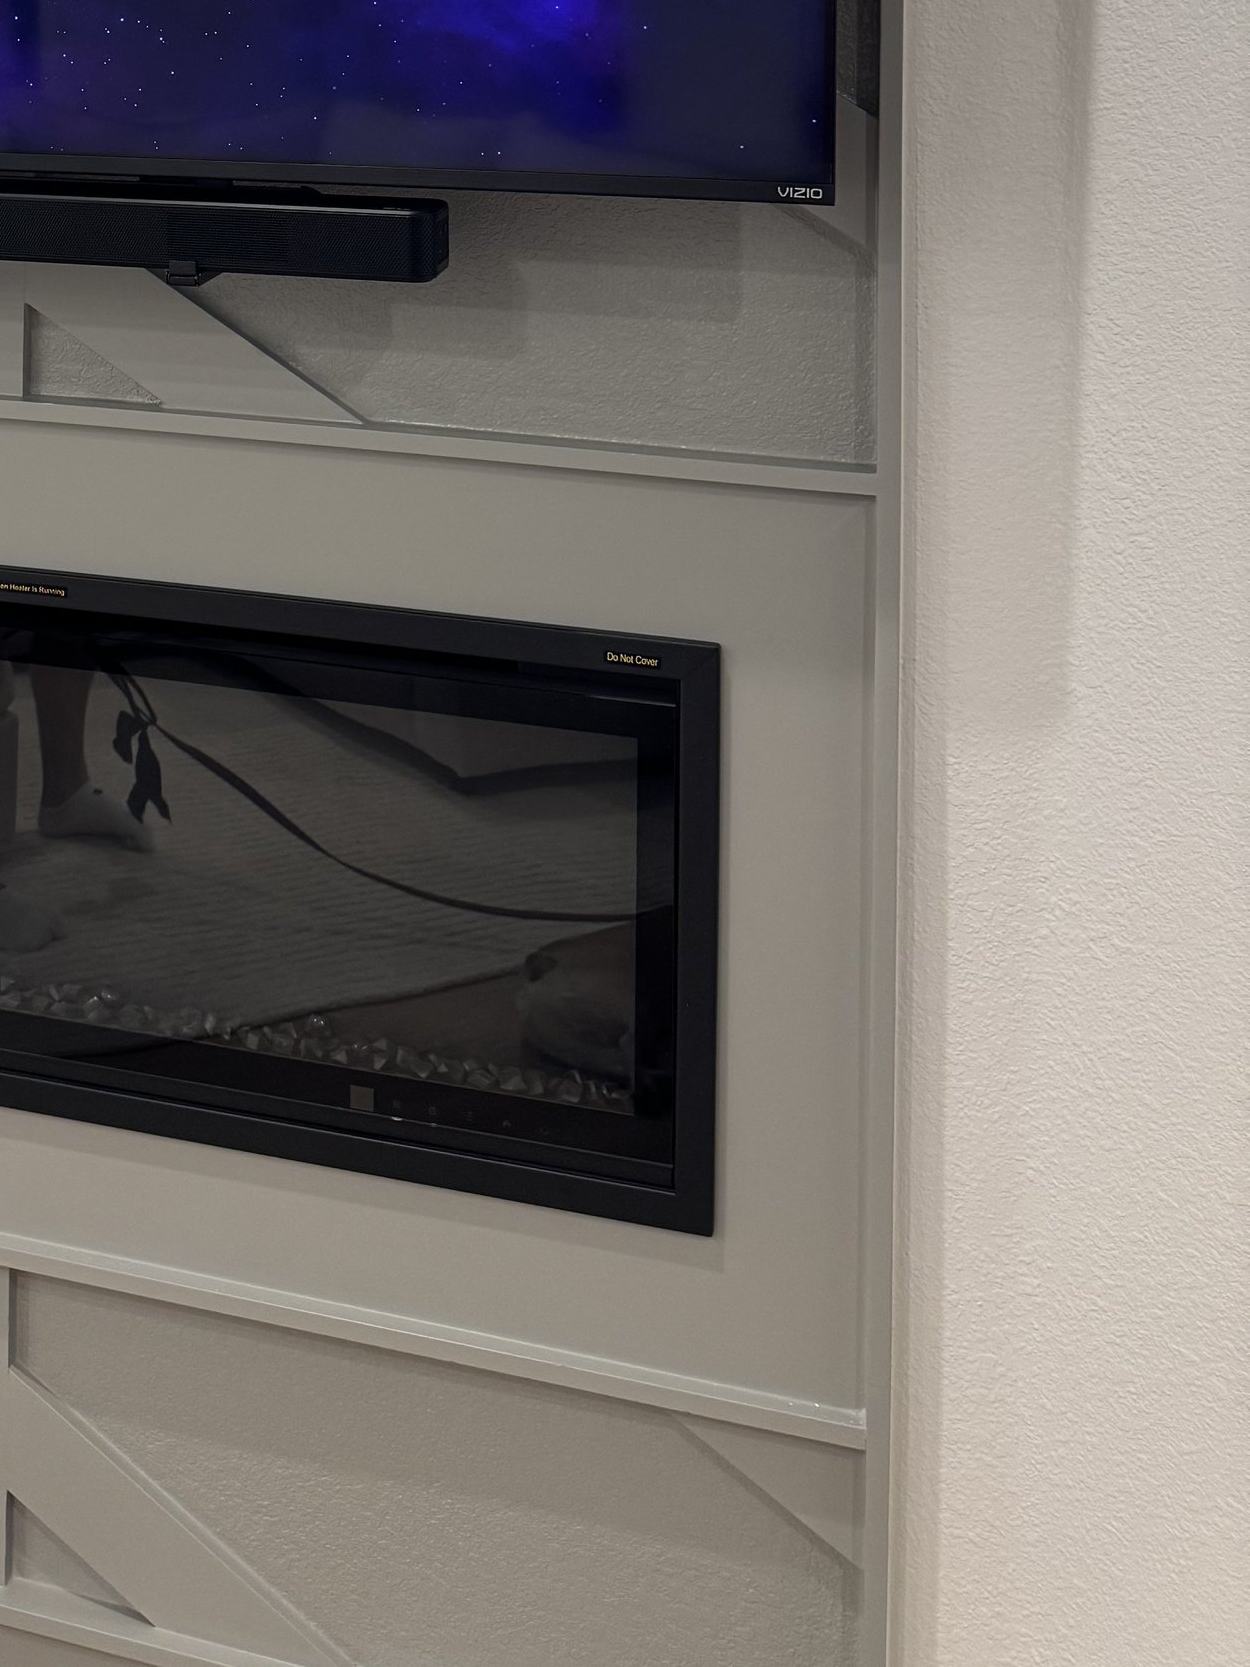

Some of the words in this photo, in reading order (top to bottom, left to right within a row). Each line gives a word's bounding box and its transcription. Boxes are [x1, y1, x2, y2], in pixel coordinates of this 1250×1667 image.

[777, 186, 823, 199] VIZIO
[607, 652, 618, 662] Do
[620, 653, 633, 664] Not
[635, 655, 658, 666] Cover
